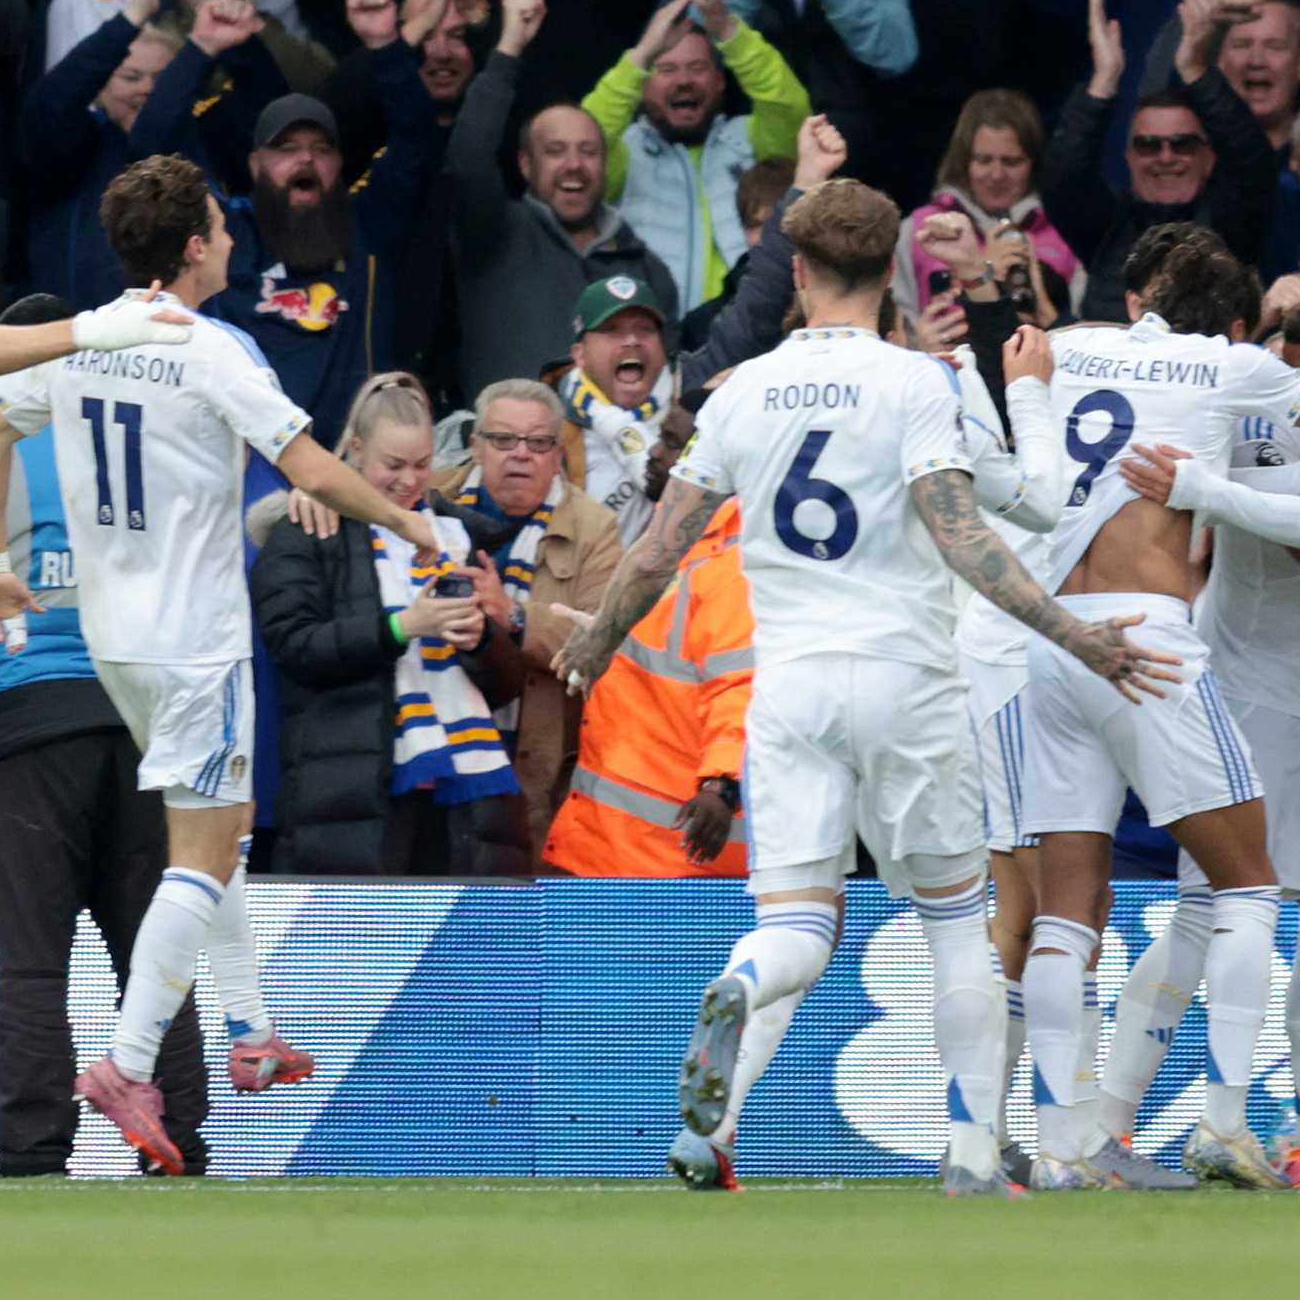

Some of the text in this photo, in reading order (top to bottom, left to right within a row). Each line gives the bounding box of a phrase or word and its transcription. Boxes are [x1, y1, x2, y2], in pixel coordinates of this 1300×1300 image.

[764, 383, 861, 412] RODON
[1064, 389, 1135, 507] 9
[81, 395, 146, 531] 11
[774, 430, 858, 561] 6
